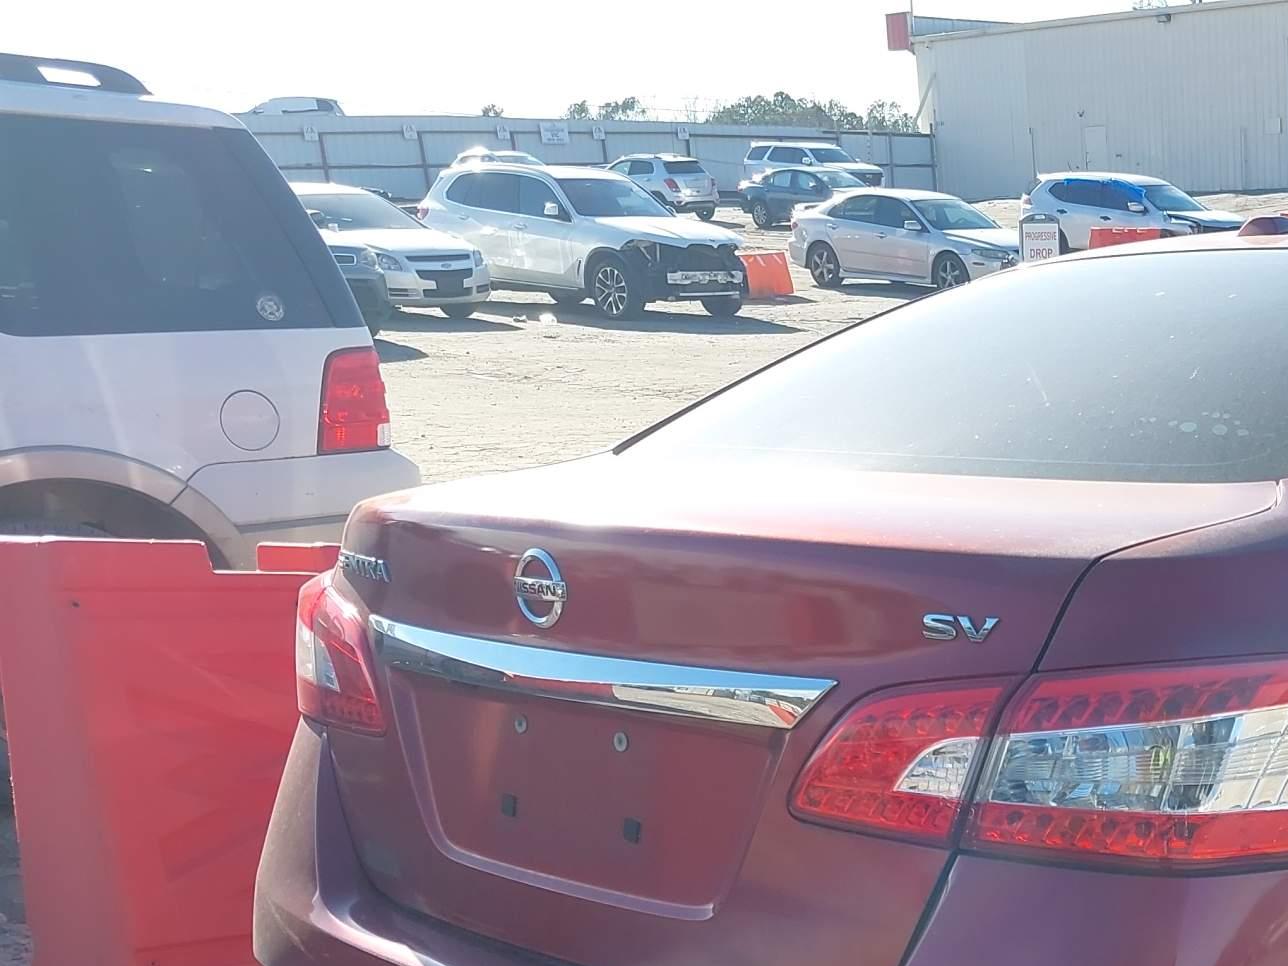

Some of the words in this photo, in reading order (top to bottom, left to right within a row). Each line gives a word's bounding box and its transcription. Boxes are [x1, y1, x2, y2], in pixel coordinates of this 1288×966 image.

[1030, 248, 1053, 259] DROP
[514, 580, 557, 597] NISSAN
[923, 614, 999, 642] SV
